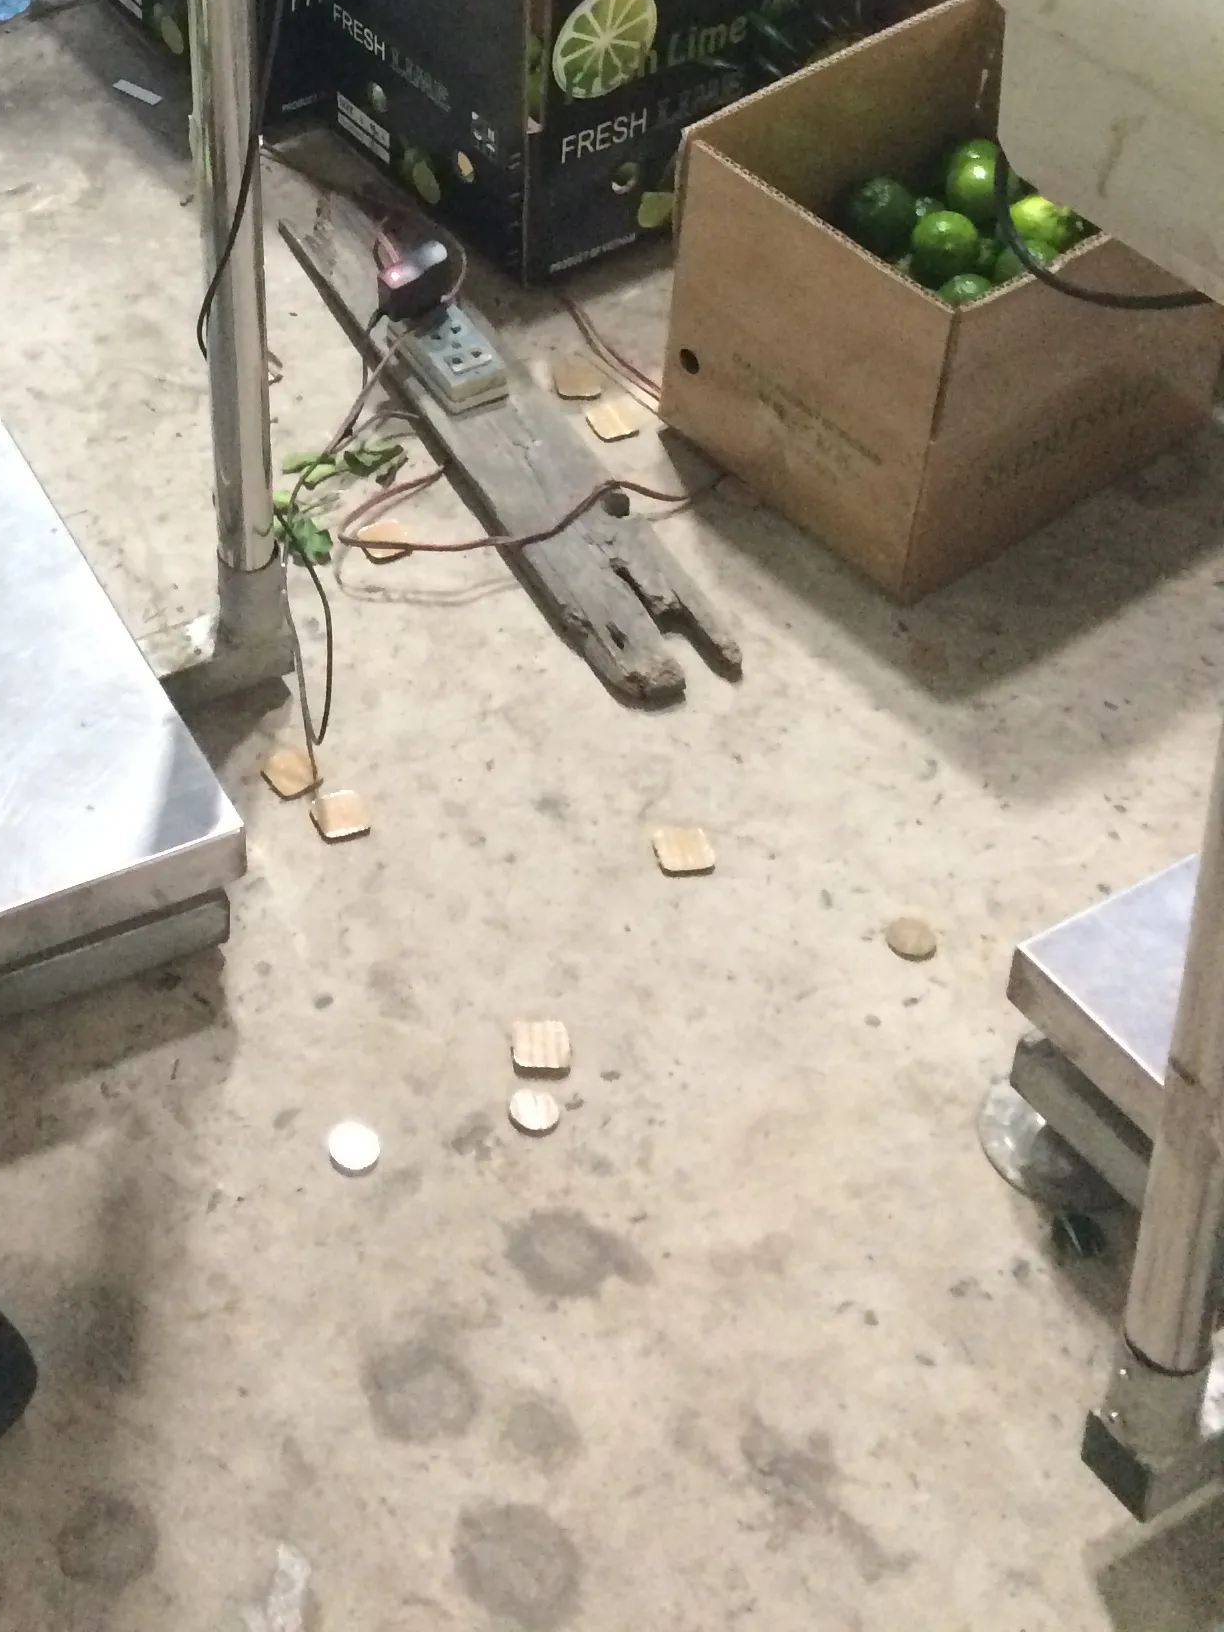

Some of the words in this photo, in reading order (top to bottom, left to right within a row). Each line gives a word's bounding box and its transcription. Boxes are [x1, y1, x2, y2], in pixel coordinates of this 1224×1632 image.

[333, 3, 386, 62] FRESH
[667, 15, 748, 67] Lime
[561, 108, 648, 164] FRESH
